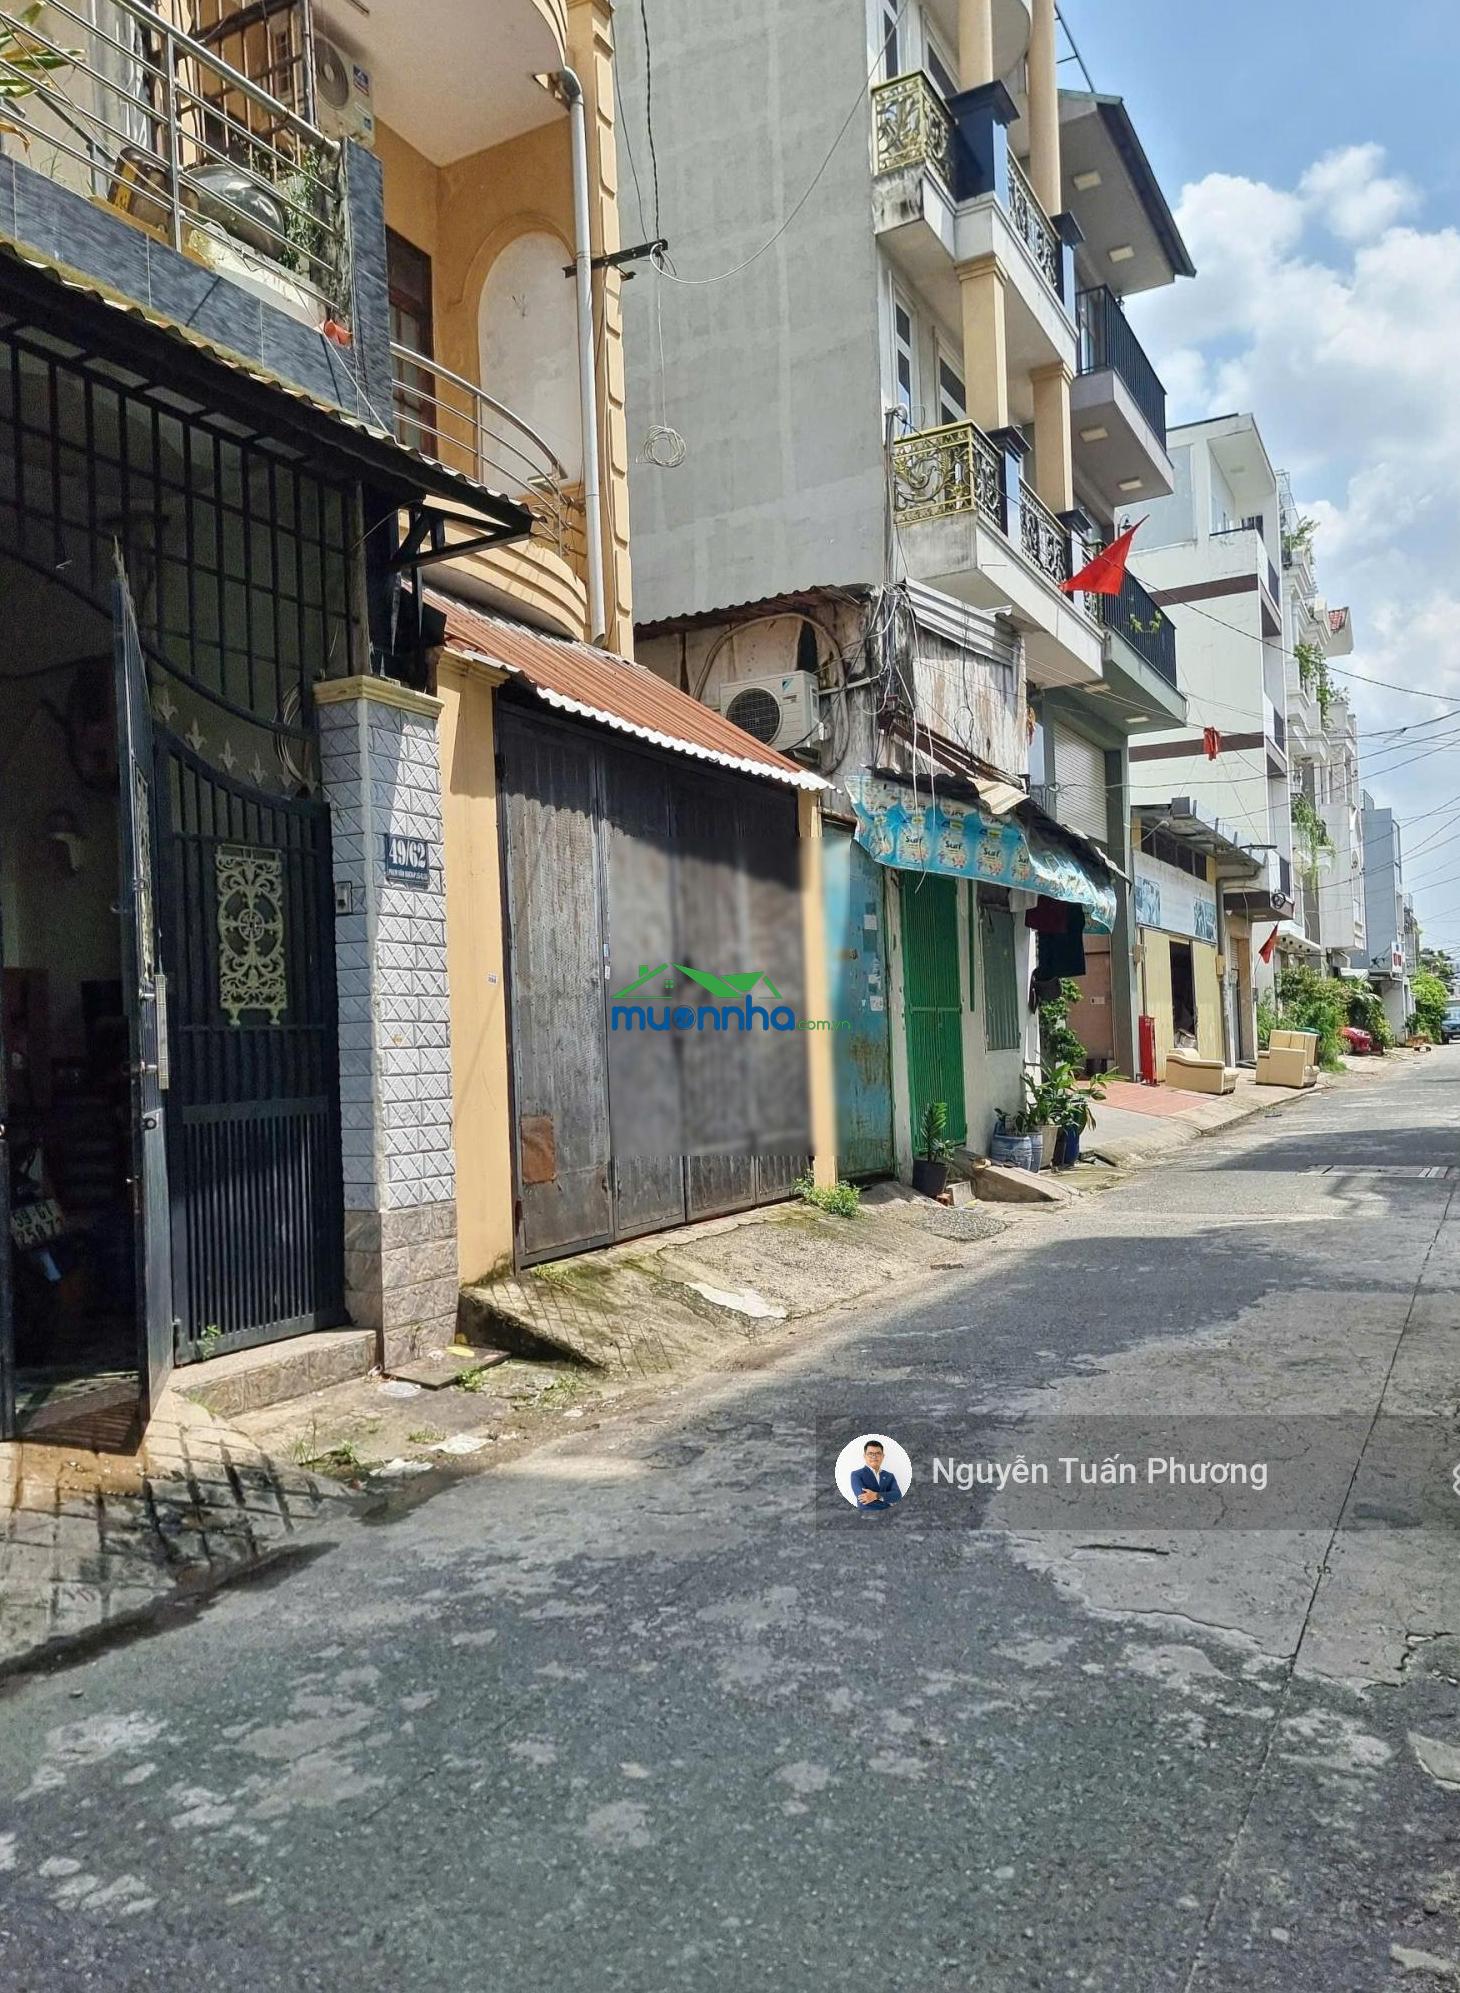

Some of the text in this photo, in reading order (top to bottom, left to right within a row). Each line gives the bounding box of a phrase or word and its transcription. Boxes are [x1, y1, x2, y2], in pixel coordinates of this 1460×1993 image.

[945, 841, 962, 849] Surf
[388, 838, 426, 868] 49/62
[983, 848, 1001, 857] Surf
